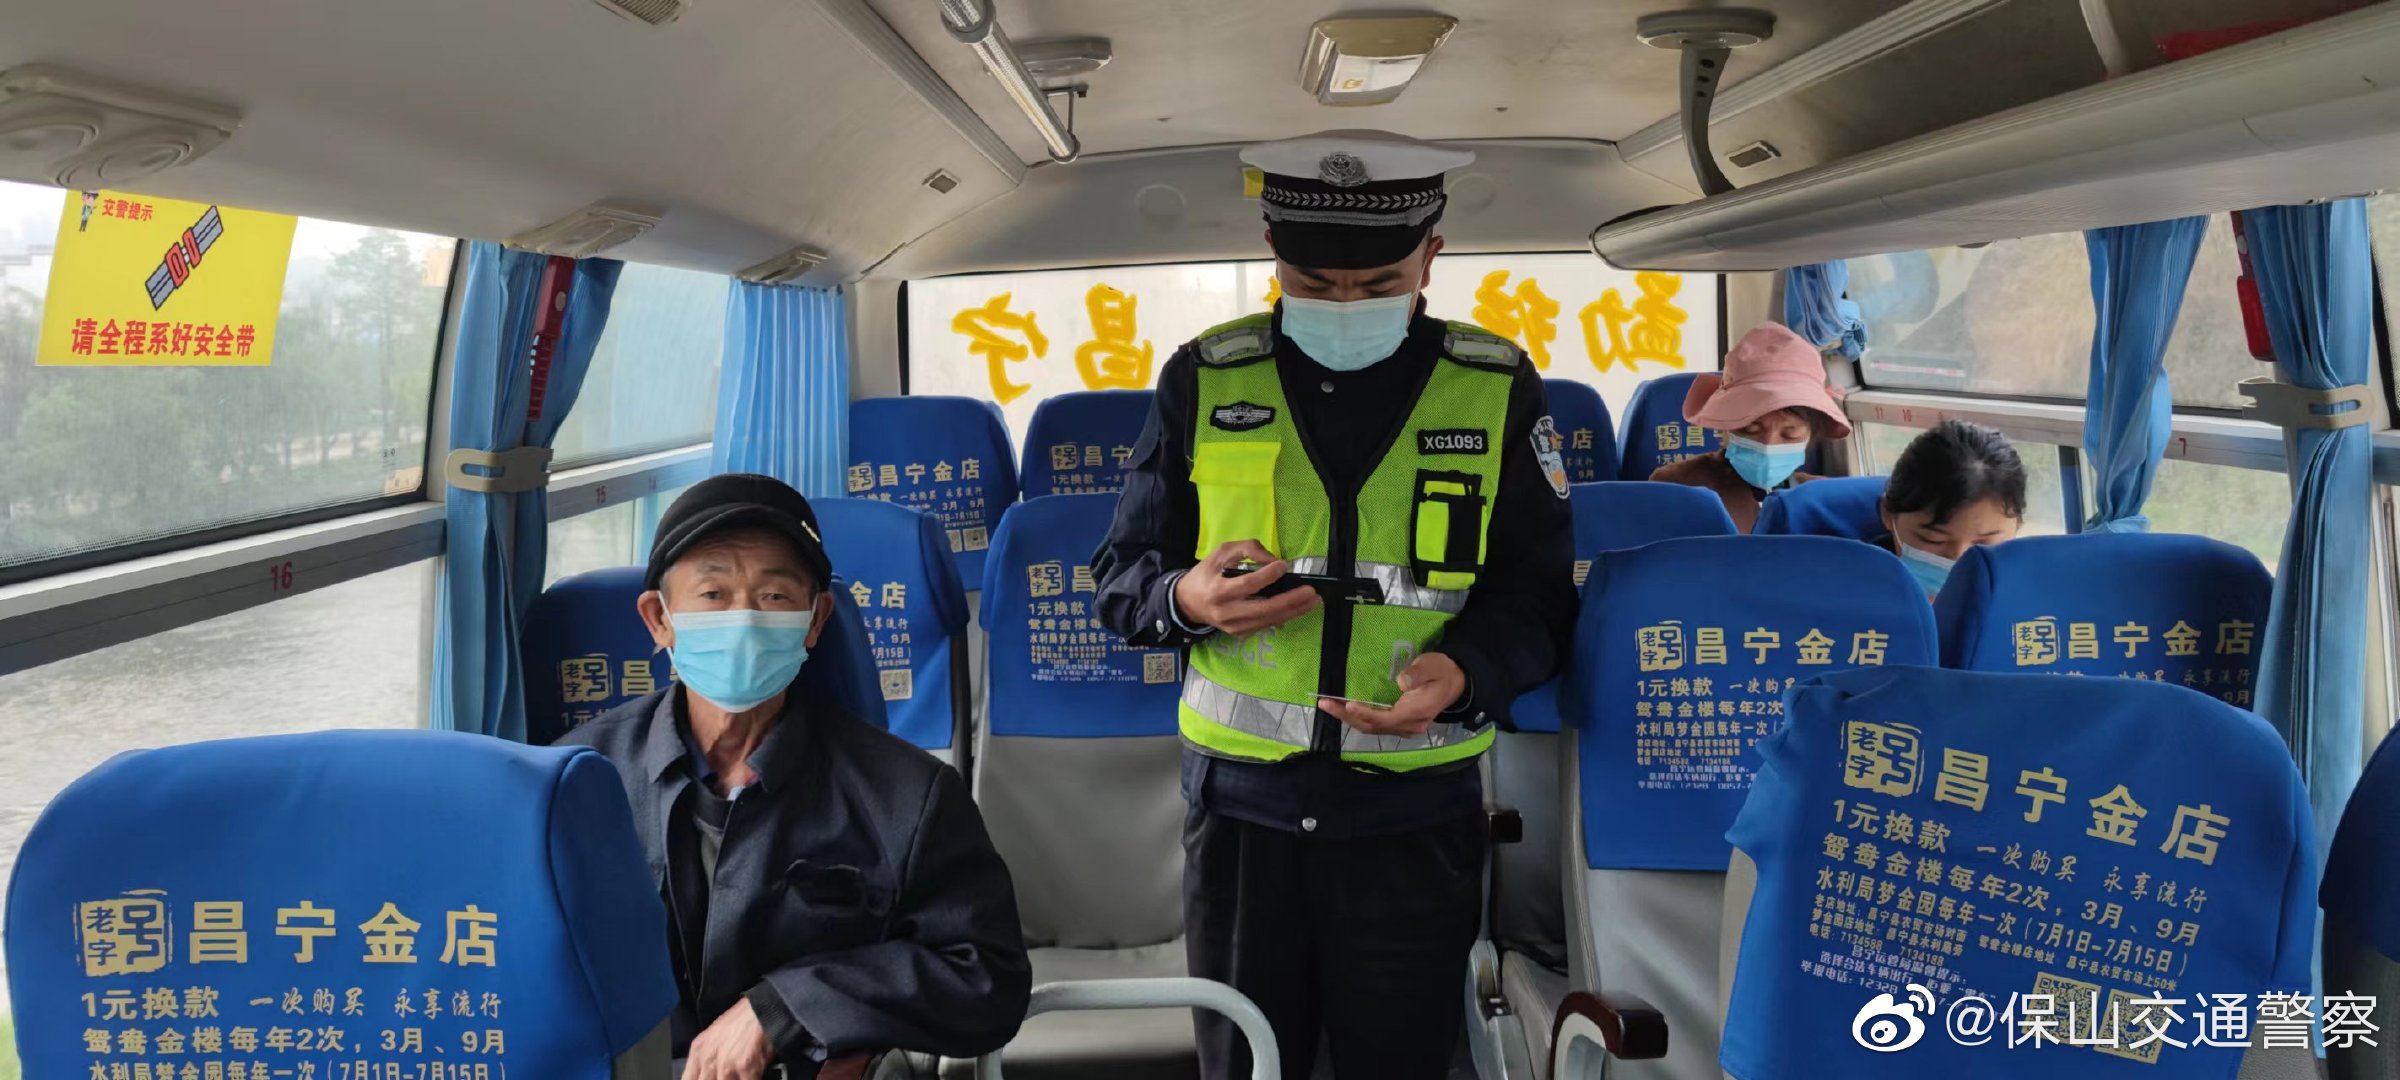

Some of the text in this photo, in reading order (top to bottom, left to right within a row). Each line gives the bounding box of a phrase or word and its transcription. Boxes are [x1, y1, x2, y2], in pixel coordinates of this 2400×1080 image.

[102, 198, 153, 222] 交警提示
[71, 318, 256, 357] 请全程系好安全带
[1424, 434, 1483, 450] XG1093
[2178, 437, 2187, 457] 7
[879, 458, 980, 487] 昌宁金店
[270, 561, 293, 592] 16
[1694, 627, 1890, 666] 昌宁金店
[2067, 620, 2255, 660] 昌宁金店
[1637, 677, 1713, 697] 1元换款
[1848, 726, 2231, 866] 老字号 昌宁金店
[1833, 800, 2207, 914] 1元换款 一次购买 永享流行
[86, 900, 498, 967] 老字号 昌宁金店
[81, 985, 502, 1021] 1元换款 一次购买 永享流行
